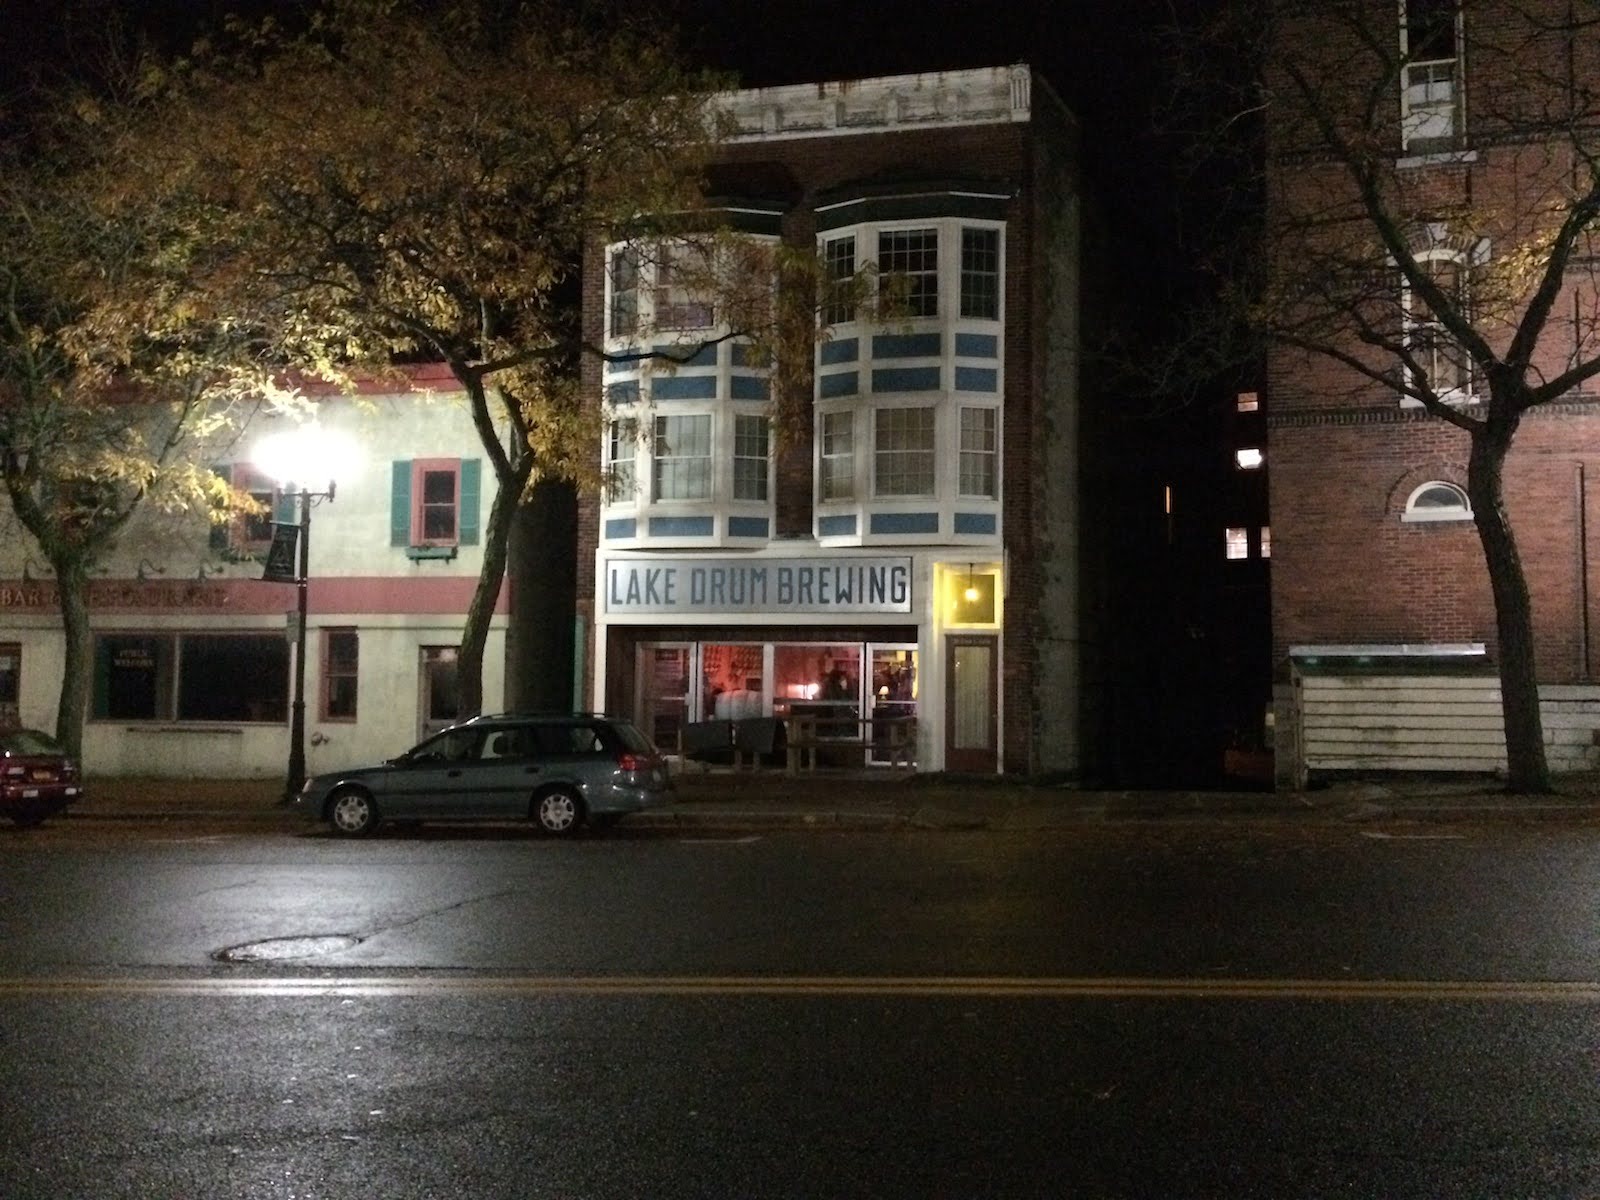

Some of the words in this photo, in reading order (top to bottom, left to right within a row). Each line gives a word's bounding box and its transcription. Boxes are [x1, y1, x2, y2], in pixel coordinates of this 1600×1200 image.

[1, 588, 40, 607] BAR
[610, 567, 677, 605] LAKE
[690, 567, 768, 605] DRUM
[776, 566, 907, 605] BREWING
